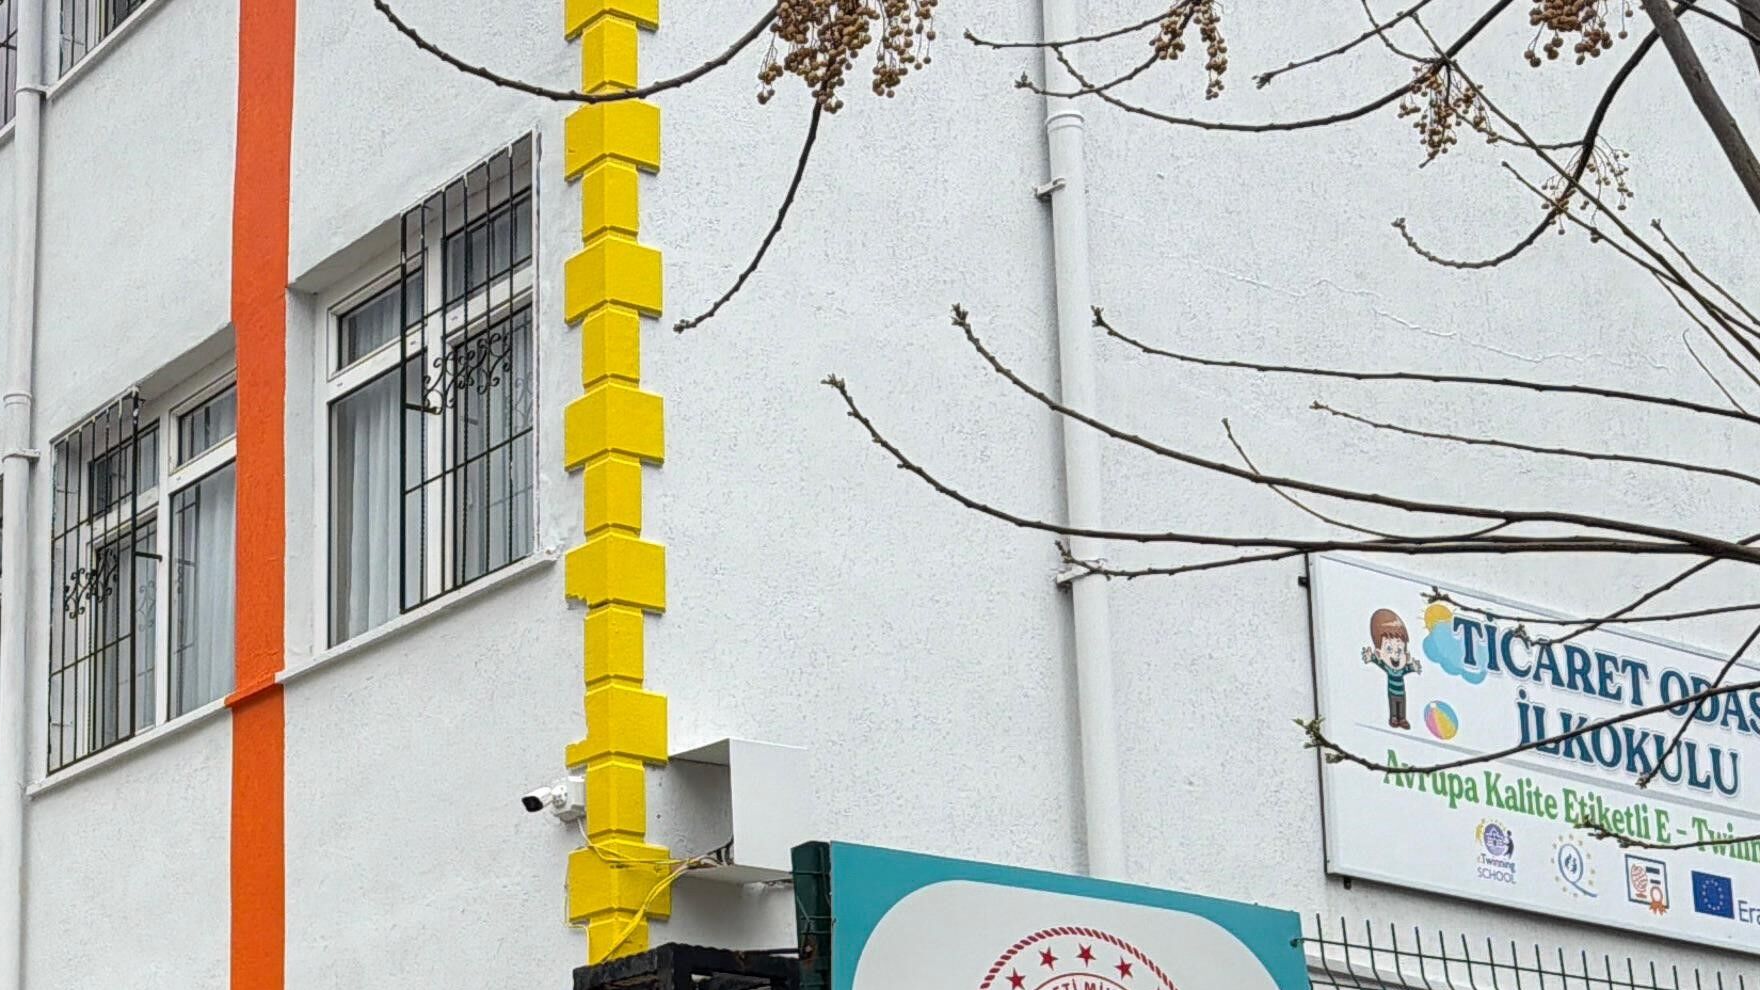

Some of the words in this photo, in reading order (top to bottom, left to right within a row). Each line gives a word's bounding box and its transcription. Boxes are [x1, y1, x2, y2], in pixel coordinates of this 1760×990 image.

[1453, 612, 1649, 706] TİCARET
[1516, 689, 1740, 795] İLKOKULU
[1384, 749, 1480, 809] Avrupa
[1483, 770, 1558, 820] Kalite
[1563, 789, 1650, 842] Etiketli
[1655, 808, 1671, 844] E
[1477, 867, 1517, 885] SCHOOL
